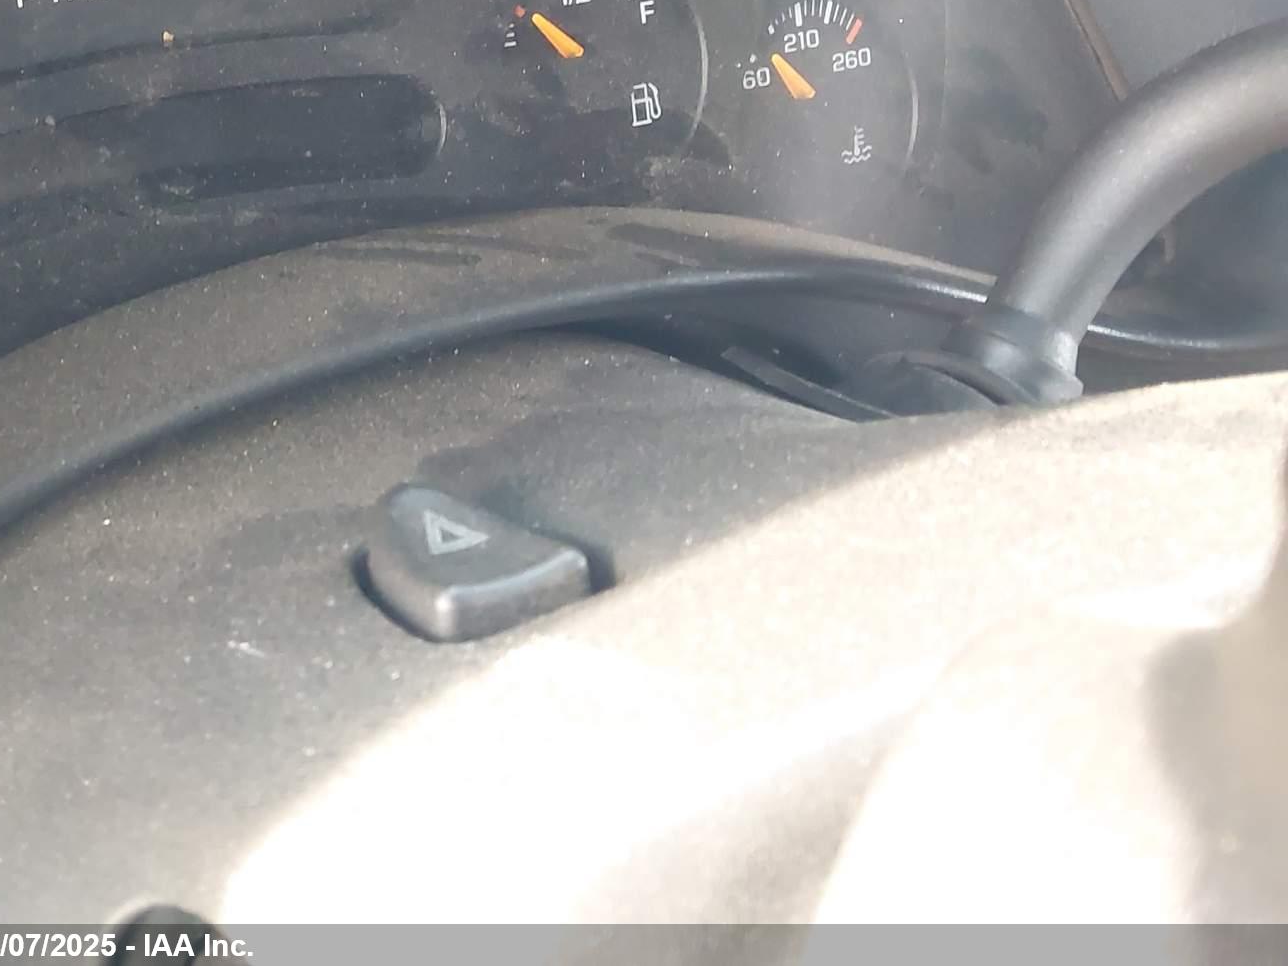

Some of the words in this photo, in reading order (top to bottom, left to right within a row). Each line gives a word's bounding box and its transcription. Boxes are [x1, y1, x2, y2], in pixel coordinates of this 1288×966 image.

[639, 0, 655, 24] F
[783, 29, 820, 53] 210
[832, 47, 871, 72] 260
[742, 67, 771, 89] 60
